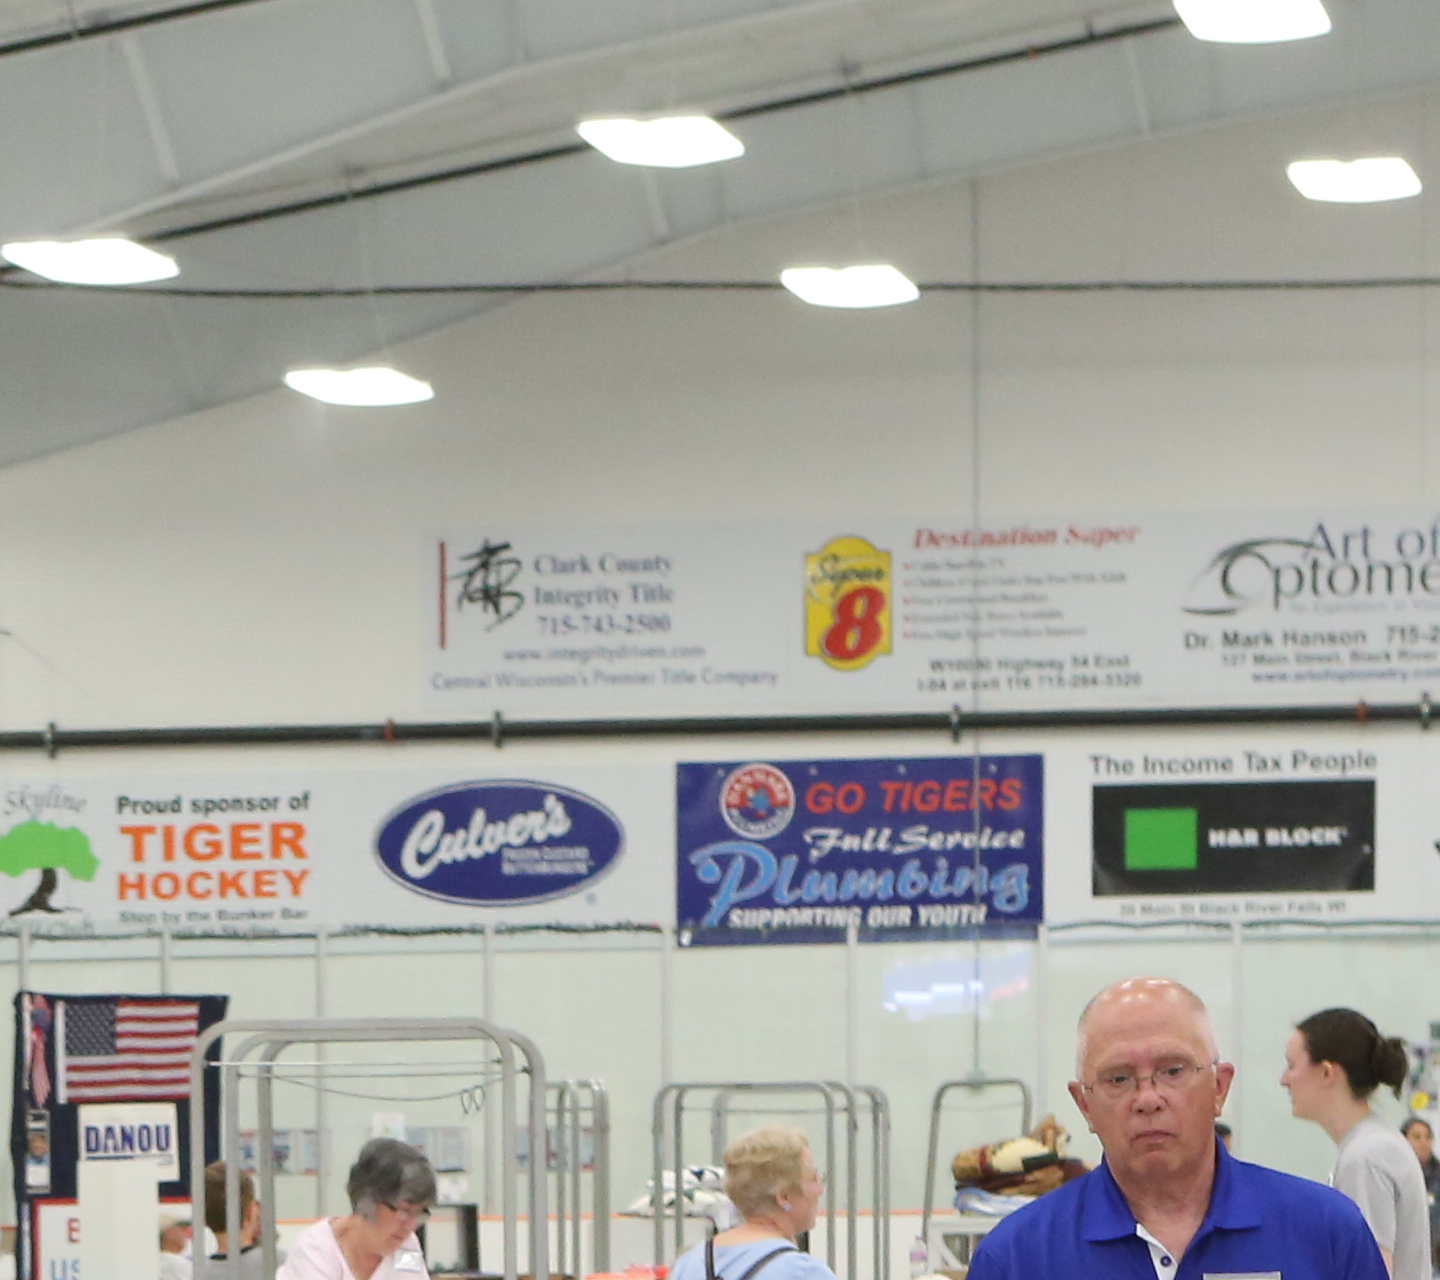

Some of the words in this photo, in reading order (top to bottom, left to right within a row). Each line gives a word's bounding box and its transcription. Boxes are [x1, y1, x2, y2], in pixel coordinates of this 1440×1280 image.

[1302, 522, 1370, 561] Art
[533, 554, 592, 575] Clark
[599, 554, 672, 577] County
[534, 586, 619, 608] Integrity
[630, 584, 674, 604] Title
[823, 586, 886, 661] 8
[1184, 631, 1211, 649] Dr.
[1222, 631, 1273, 648] Mark
[1090, 754, 1134, 775] The
[1143, 753, 1235, 774] Income
[1243, 750, 1282, 771] Tax
[1292, 749, 1377, 774] People
[118, 795, 183, 814] Proud
[191, 795, 279, 818] sponsor
[289, 790, 311, 811] of
[805, 783, 866, 815] GO
[880, 778, 1025, 813] TIGERS
[120, 822, 309, 863] TIGER
[401, 794, 572, 880] Culver's
[803, 826, 892, 864] Full
[892, 825, 1026, 856] Service
[1208, 828, 1259, 848] H&R
[117, 868, 310, 901] HOCKEY
[688, 840, 1030, 928] Plumbing
[868, 904, 912, 927] OUR
[919, 903, 988, 926] YOUTH
